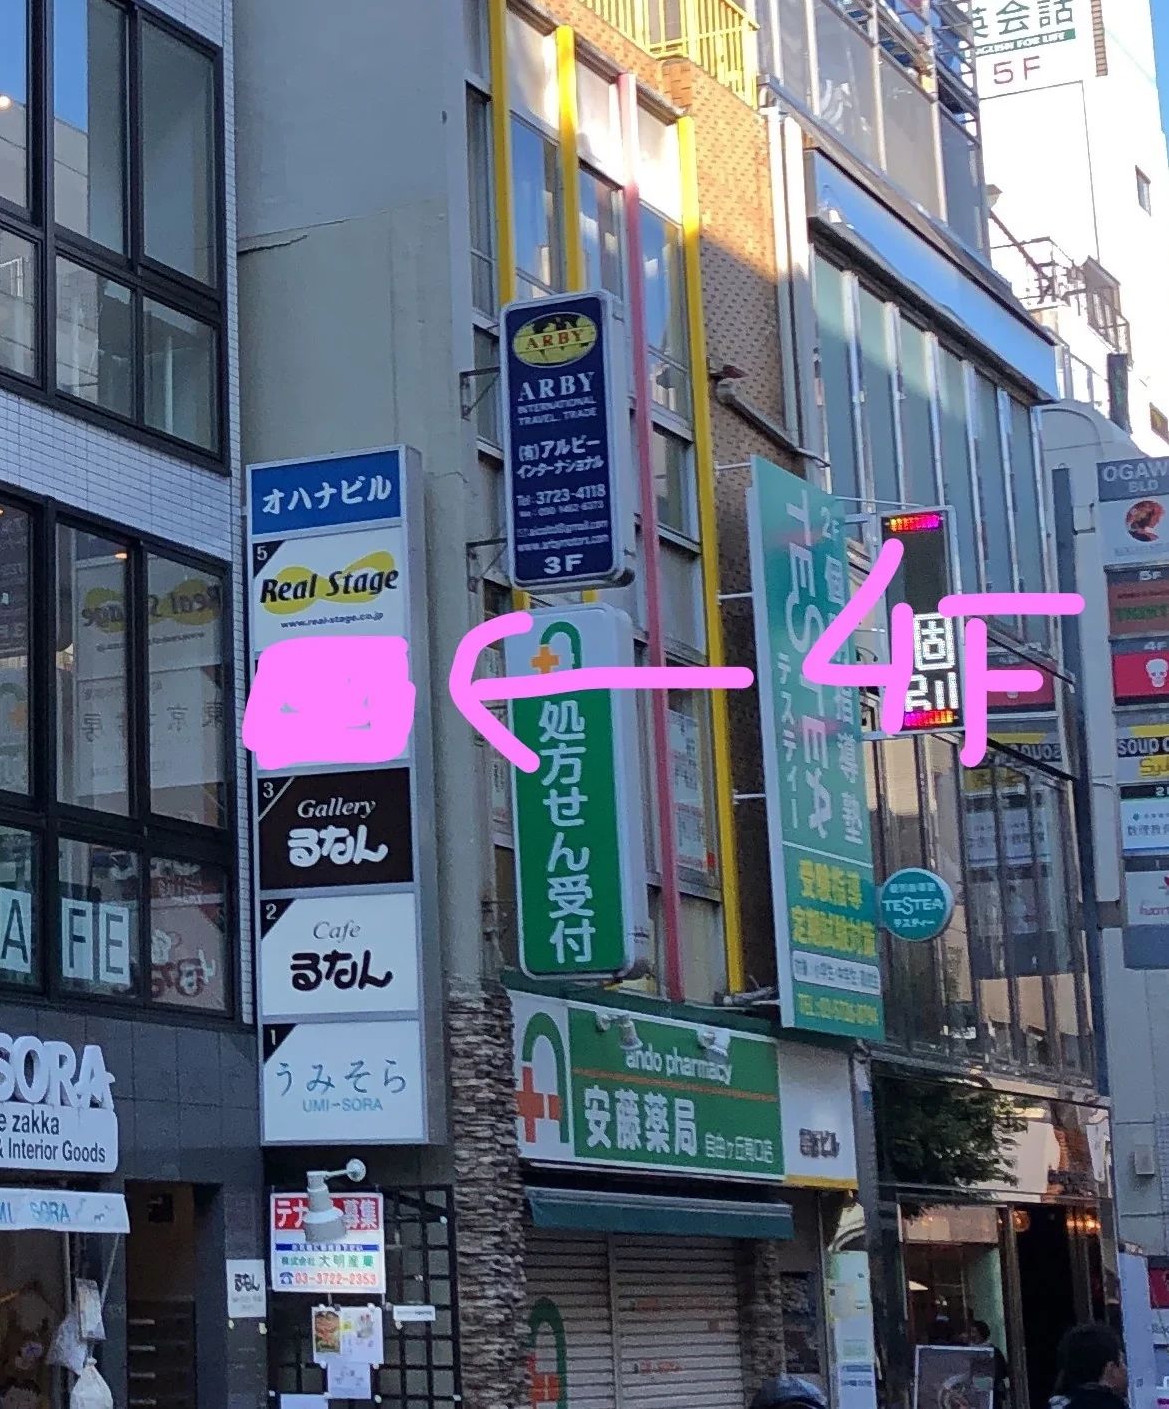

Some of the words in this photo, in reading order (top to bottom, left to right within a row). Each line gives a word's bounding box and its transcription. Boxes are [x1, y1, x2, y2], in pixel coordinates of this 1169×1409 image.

[993, 55, 1041, 85] 5F
[526, 329, 584, 351] ARBY
[518, 371, 595, 402] ARBY
[262, 474, 393, 515] オハナビル
[256, 545, 268, 561] 5
[543, 554, 584, 575] 3F
[260, 573, 318, 604] Real
[325, 569, 399, 597] Stage
[777, 652, 798, 829] テスティー
[262, 782, 274, 799] 3
[297, 796, 376, 820] Gallery
[538, 700, 597, 964] 処方せん受付
[288, 824, 389, 867] るなん
[266, 904, 277, 920] 2
[882, 896, 944, 916] TESTEA
[312, 920, 361, 944] Cafe
[290, 949, 393, 992] るなん
[270, 1029, 276, 1046] 1
[625, 1042, 663, 1072] ando
[665, 1047, 732, 1086] pharmacy
[276, 1059, 407, 1096] うみそら
[12, 1109, 60, 1135] zakka
[584, 1084, 698, 1158] 安藤薬局
[8, 1139, 59, 1161] Interior
[62, 1142, 106, 1163] Goods
[31, 1201, 72, 1224] SORA
